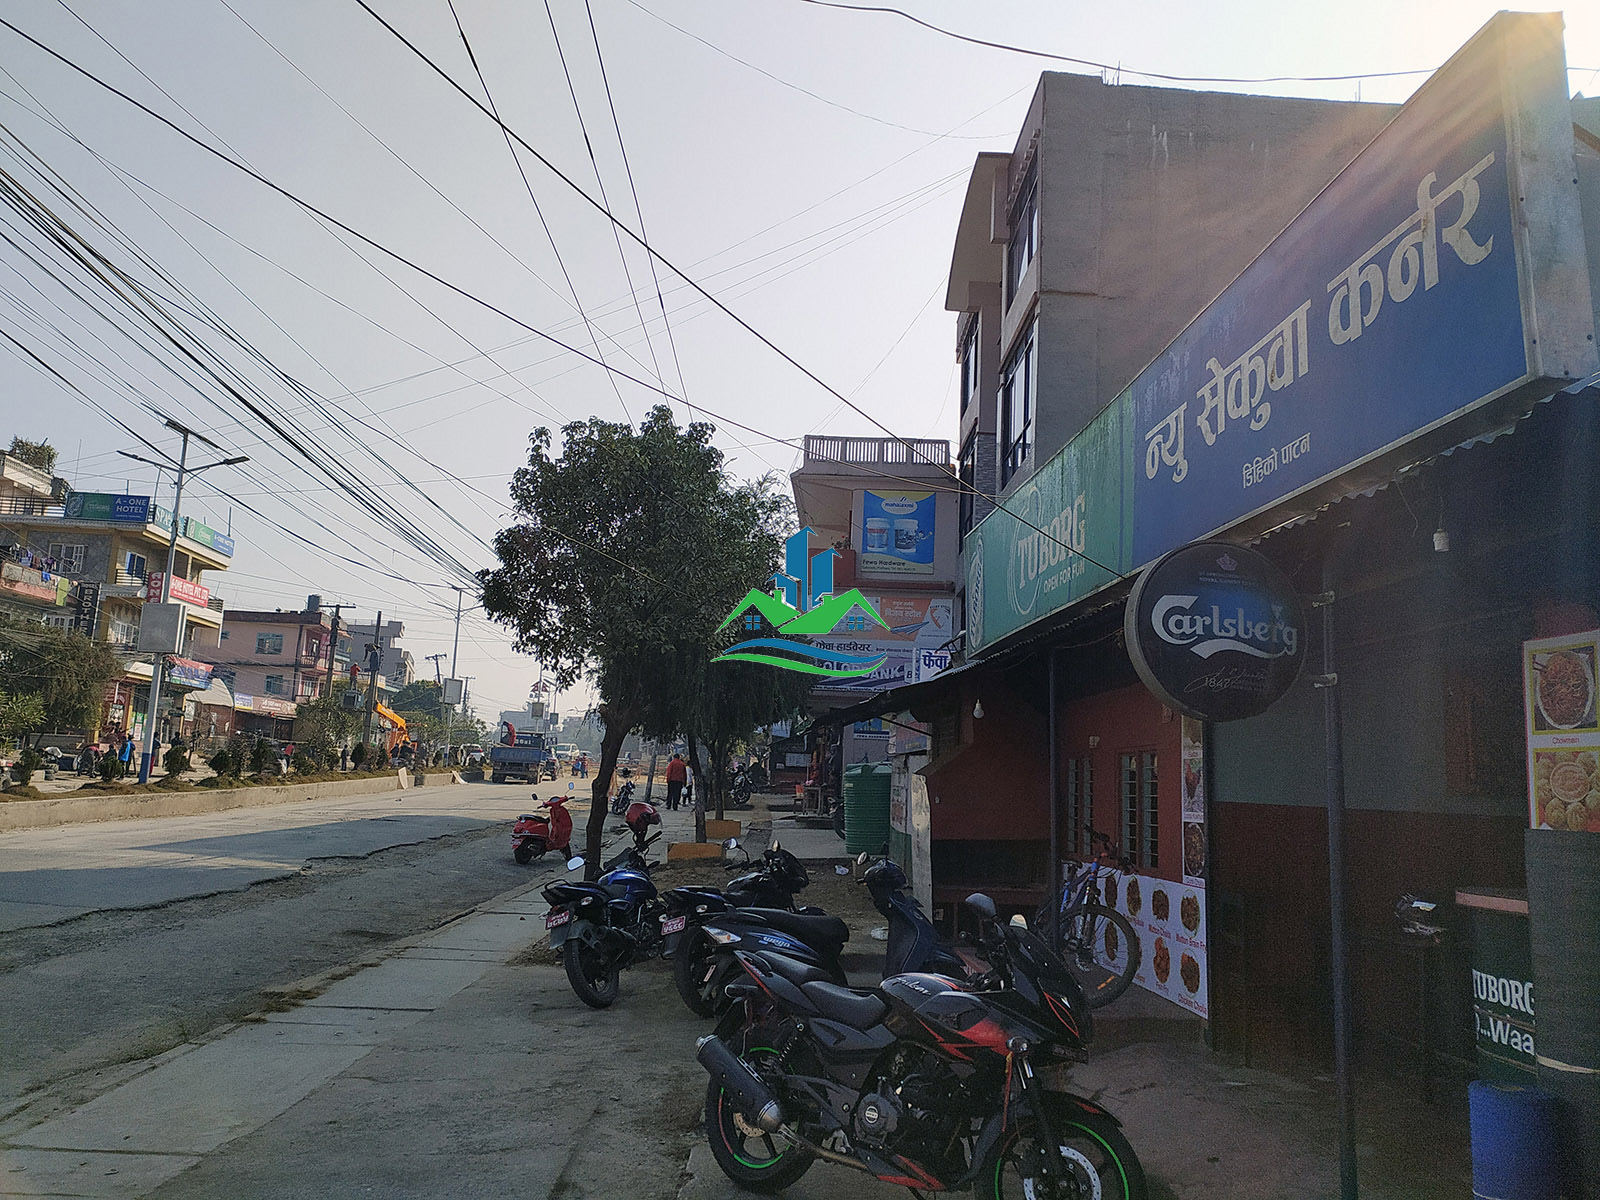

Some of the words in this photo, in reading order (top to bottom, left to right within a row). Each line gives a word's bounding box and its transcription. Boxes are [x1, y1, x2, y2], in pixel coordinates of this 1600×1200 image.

[1144, 401, 1188, 483] न्यु
[1196, 299, 1312, 447] सेकुवा
[1326, 151, 1495, 346] कर्नर
[1280, 432, 1311, 464] पाटन
[115, 506, 144, 514] HOTEL
[128, 499, 147, 507] ONE
[1017, 490, 1086, 590] TUBORG
[1043, 576, 1059, 594] OPEN
[1059, 569, 1072, 587] FOR
[1151, 594, 1299, 657] Carlsberg
[921, 651, 949, 670] फेवा
